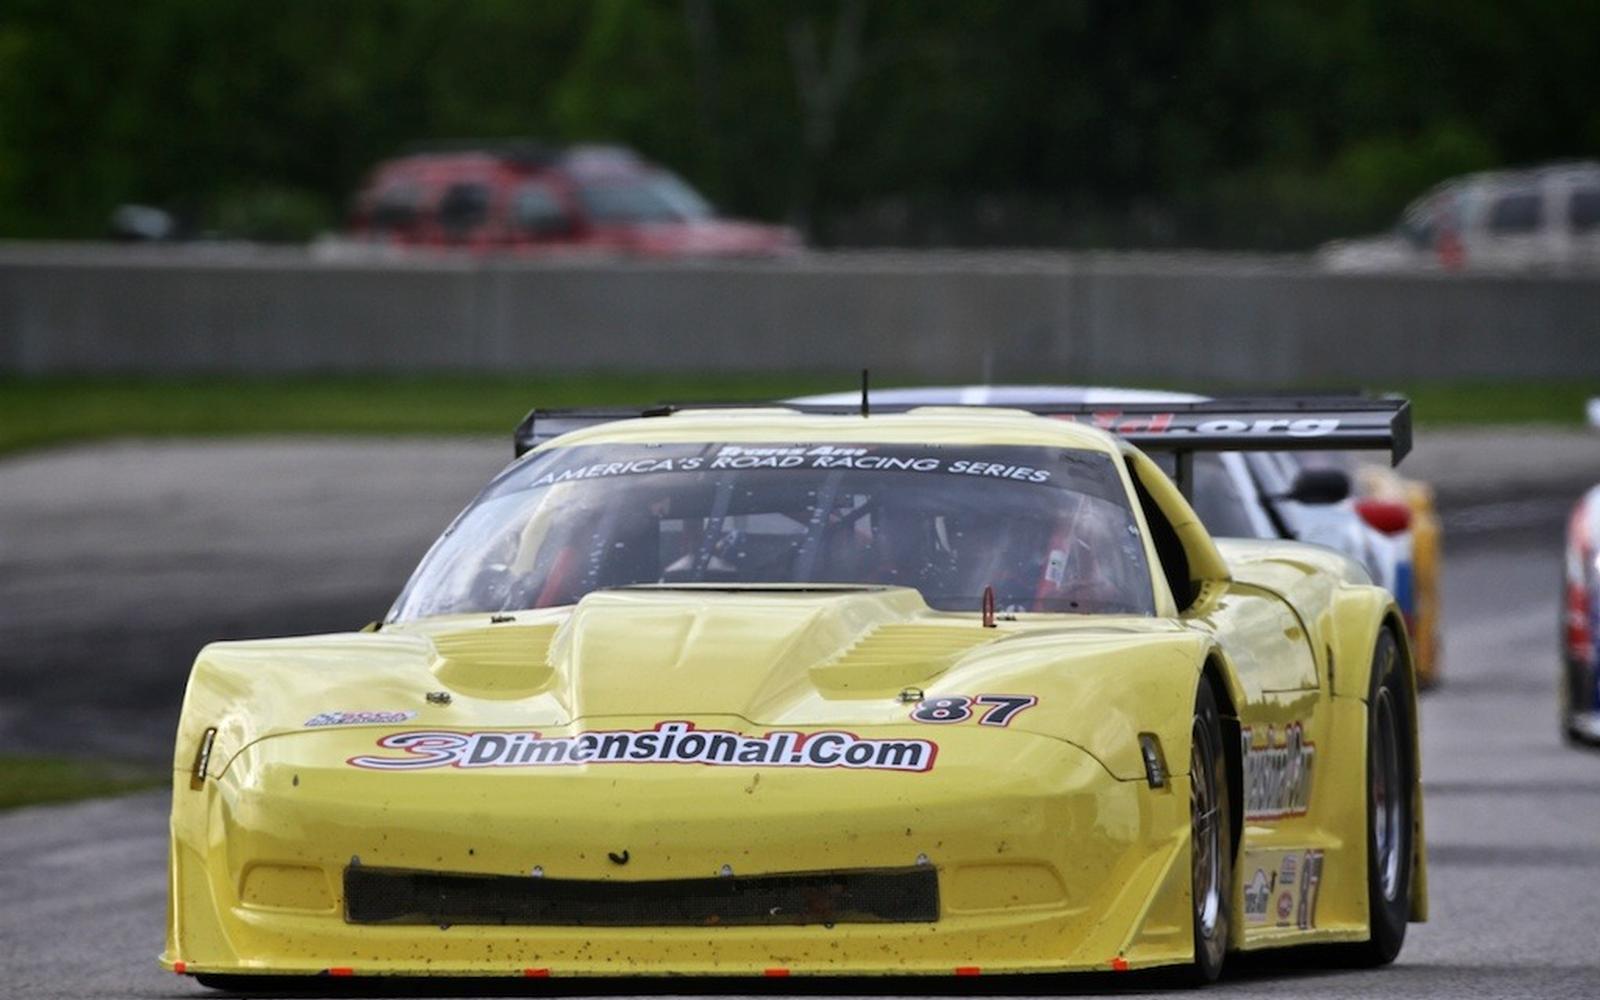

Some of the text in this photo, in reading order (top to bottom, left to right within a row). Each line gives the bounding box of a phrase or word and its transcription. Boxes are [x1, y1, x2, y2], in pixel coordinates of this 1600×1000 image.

[806, 446, 868, 456] Am
[531, 456, 1050, 487] AMERICA'S ROAD RACING SERIES
[910, 694, 1038, 728] 87
[347, 720, 938, 773] 3Dimensional.Com
